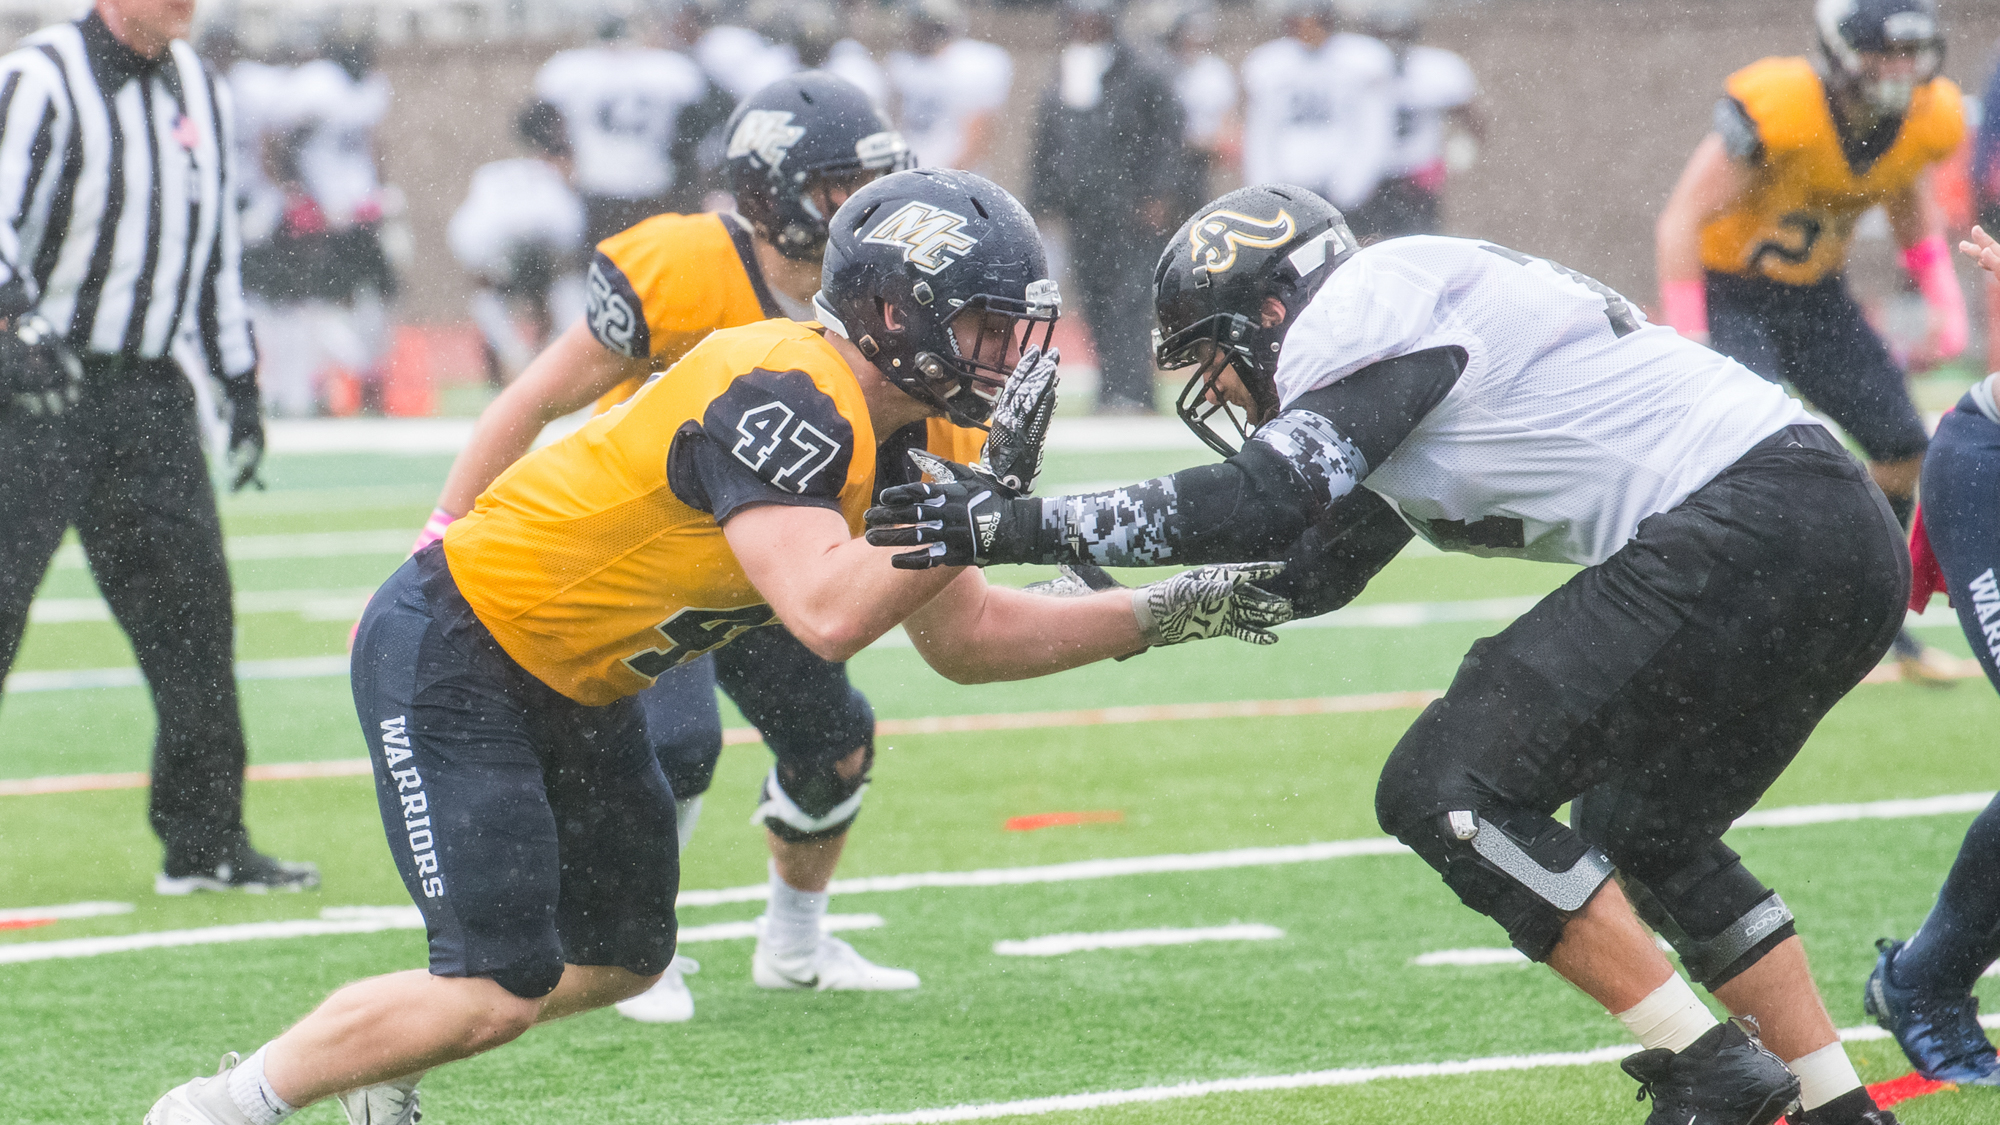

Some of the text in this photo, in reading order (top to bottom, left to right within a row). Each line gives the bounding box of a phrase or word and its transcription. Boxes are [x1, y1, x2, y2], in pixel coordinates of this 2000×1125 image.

[862, 200, 979, 275] MC
[587, 261, 635, 357] 52
[946, 326, 963, 357] Ridde
[732, 401, 842, 493] 47
[983, 511, 1002, 548] adidas
[1968, 568, 2000, 673] WAR
[380, 715, 444, 898] WARRIORS
